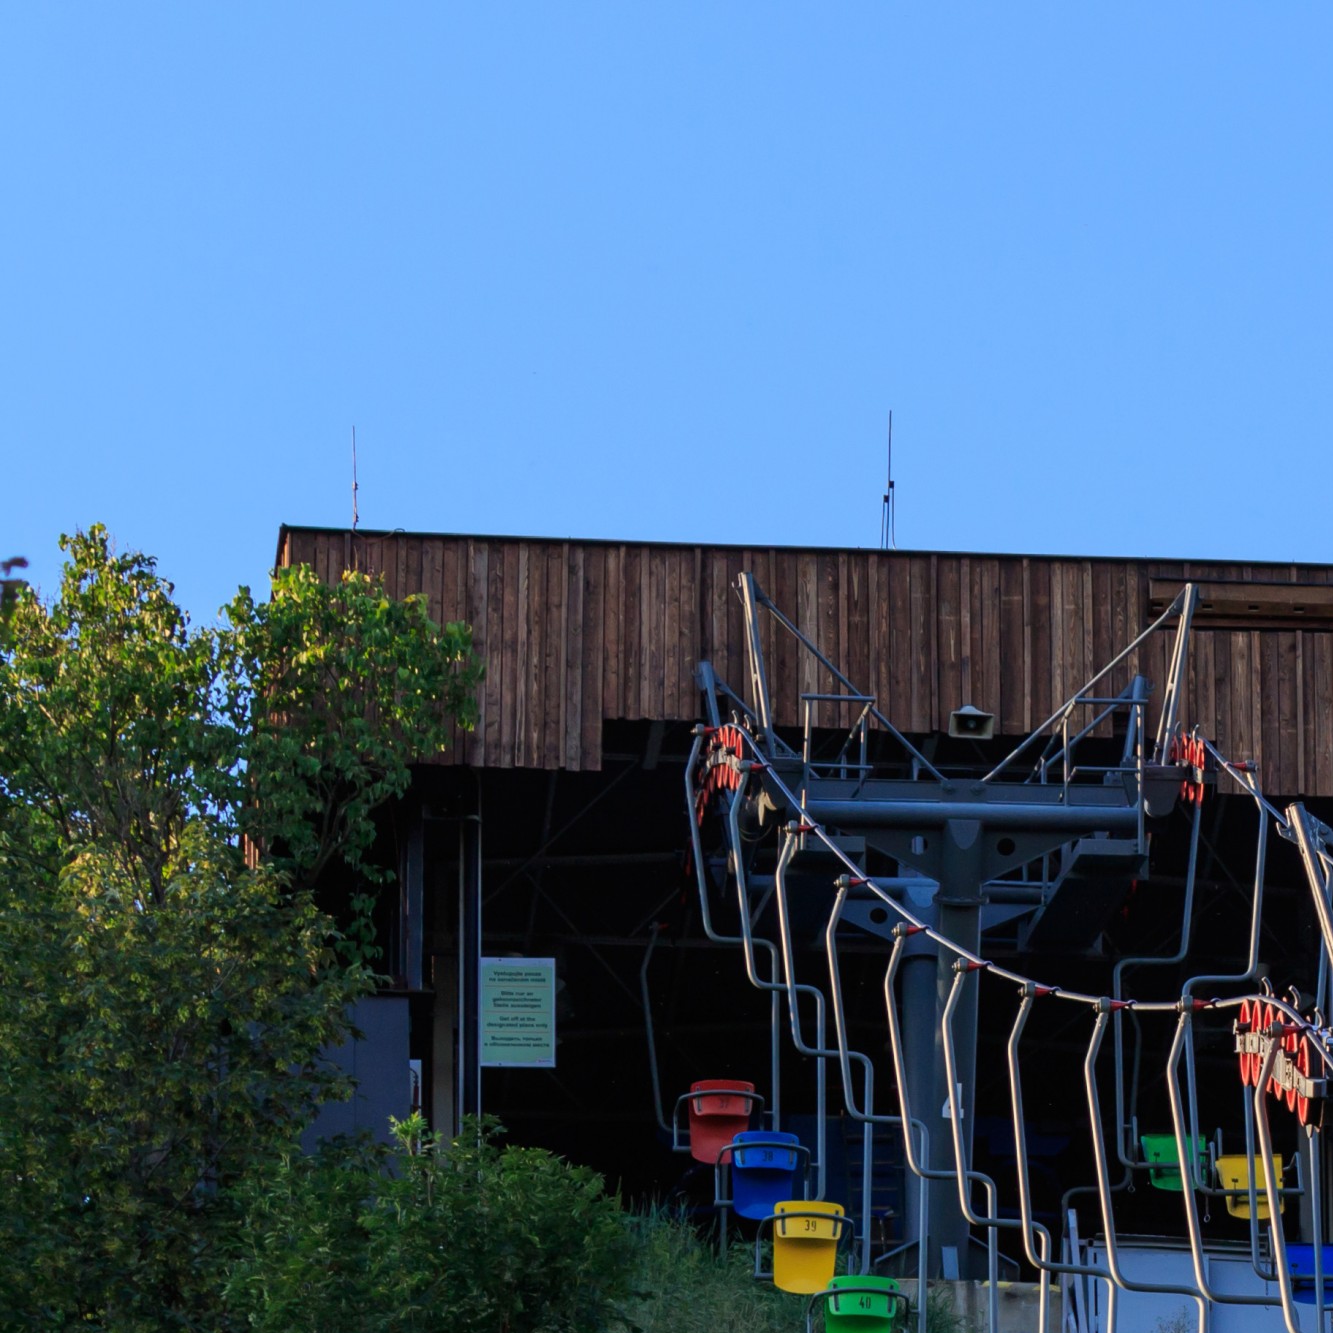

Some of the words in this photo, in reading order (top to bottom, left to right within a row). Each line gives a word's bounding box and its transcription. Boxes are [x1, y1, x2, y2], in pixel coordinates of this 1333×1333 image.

[942, 1083, 964, 1119] 4
[762, 1150, 774, 1162] 38
[804, 1219, 816, 1231] 39
[858, 1296, 871, 1309] 40
